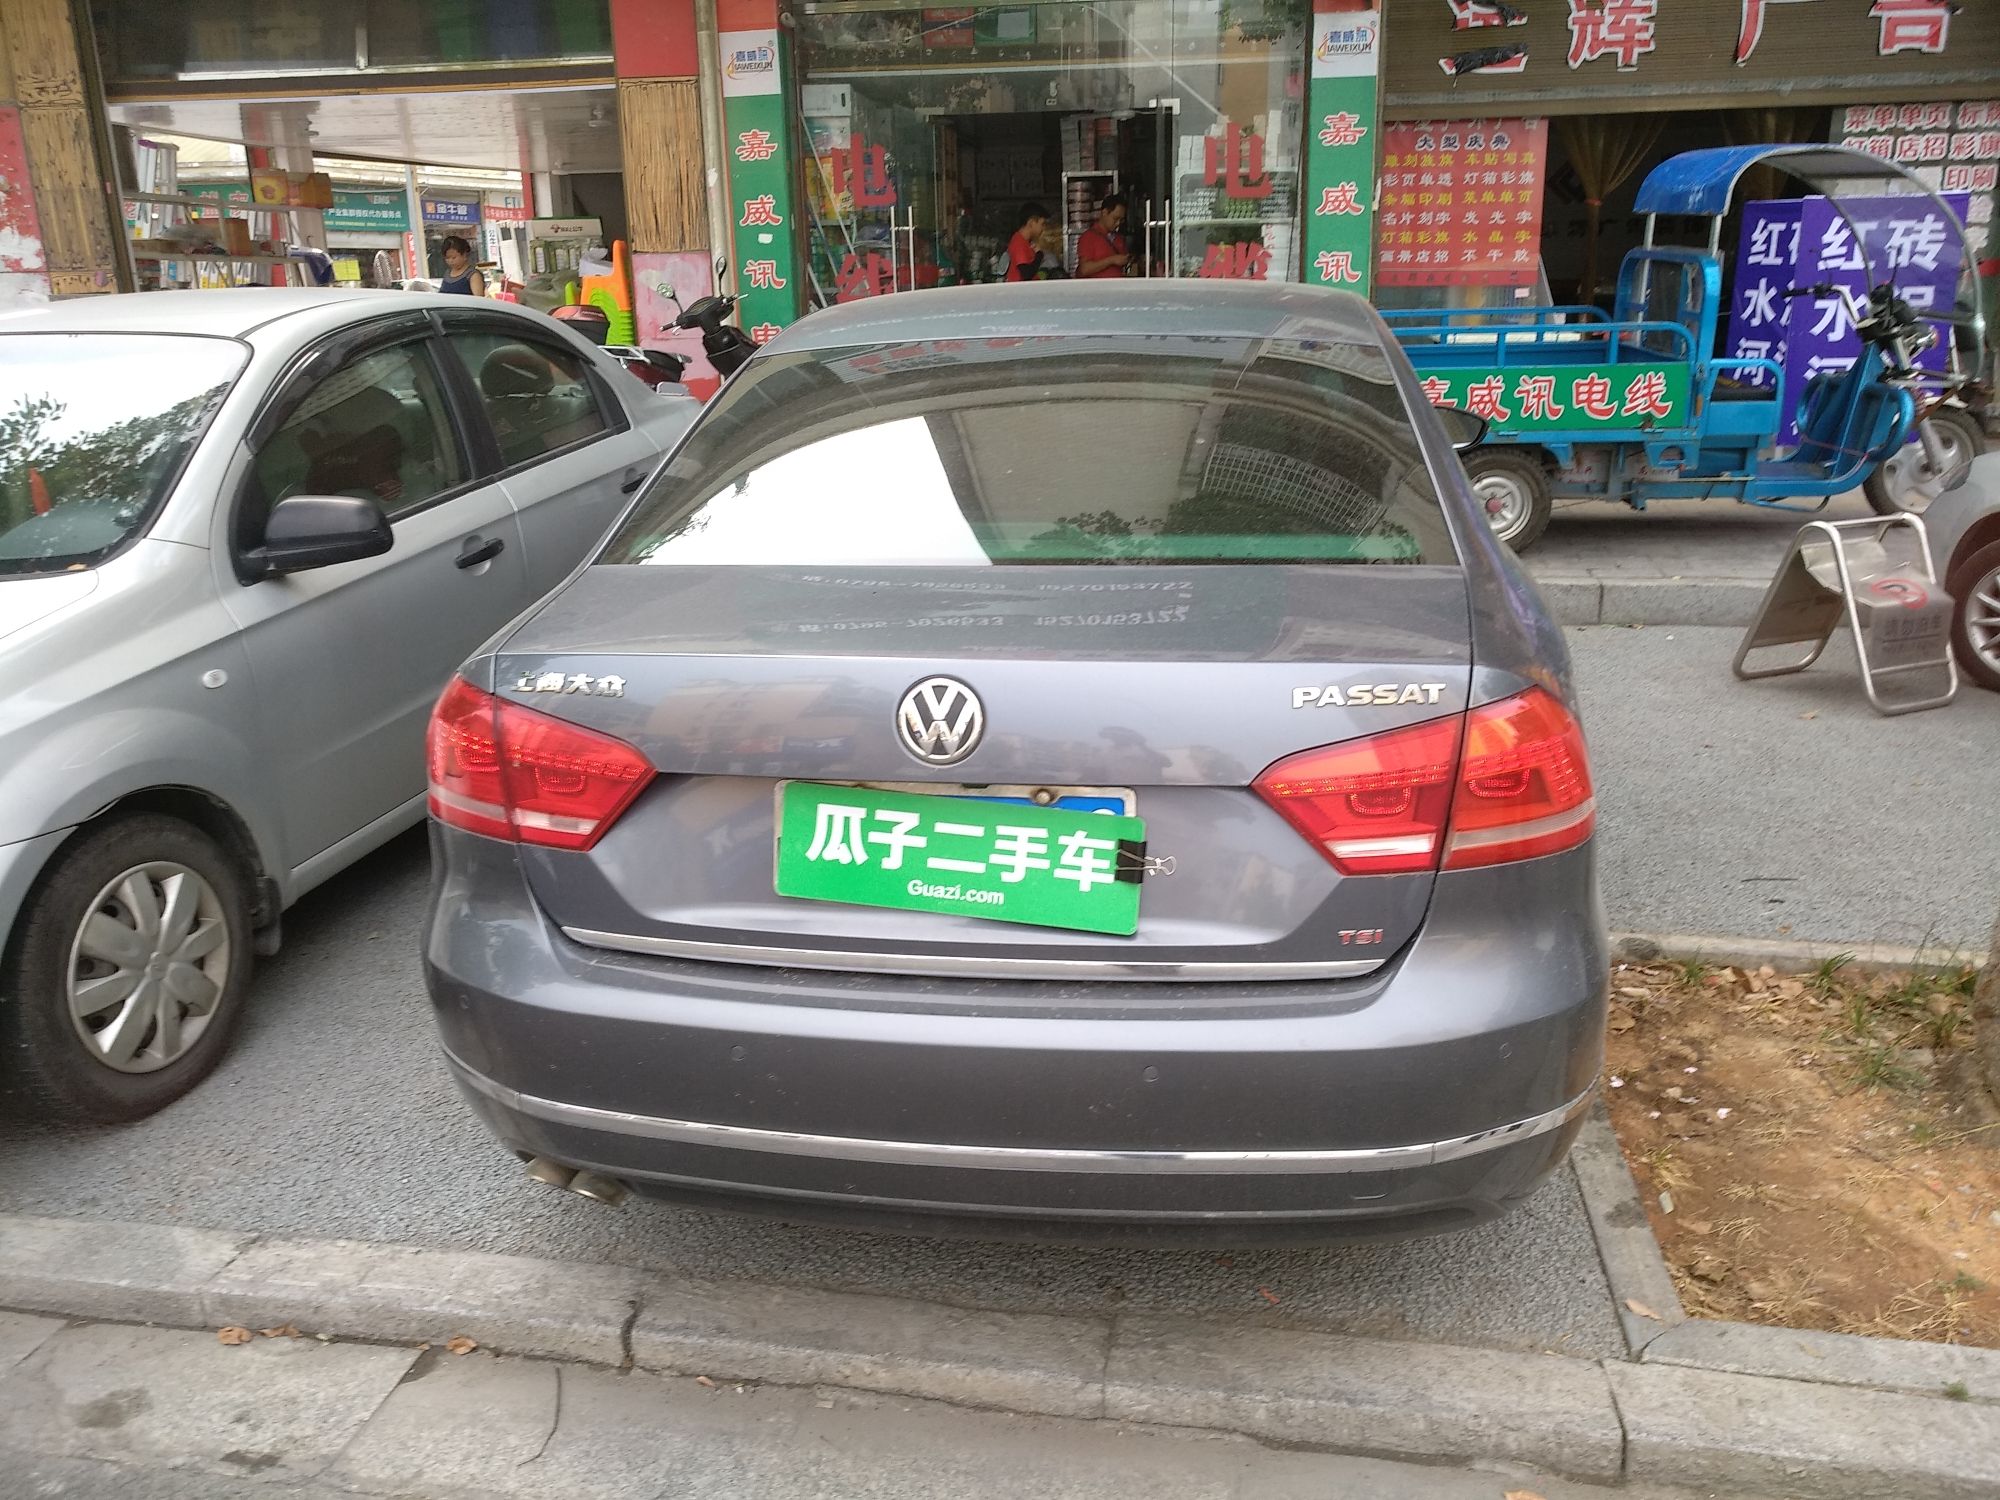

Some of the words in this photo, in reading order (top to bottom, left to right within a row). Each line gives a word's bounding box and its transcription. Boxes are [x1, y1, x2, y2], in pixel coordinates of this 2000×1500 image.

[1415, 132, 1510, 151] 大型庆典
[1463, 170, 1535, 185] 灯箱彩旗
[1945, 165, 1997, 191] 印刷
[1315, 111, 1367, 283] 嘉威讯
[1462, 209, 1533, 225] 发光字
[1380, 230, 1450, 244] 灯箱彩旗
[1461, 229, 1532, 243] 水晶字
[1816, 212, 1948, 273] 红砖
[1740, 276, 1797, 328] 水
[511, 671, 628, 698] 上海大众
[1292, 683, 1447, 709] PASSAT
[805, 802, 1117, 894] 瓜子二手车
[906, 879, 1005, 905] Guazi.com
[1337, 928, 1384, 945] TSI
